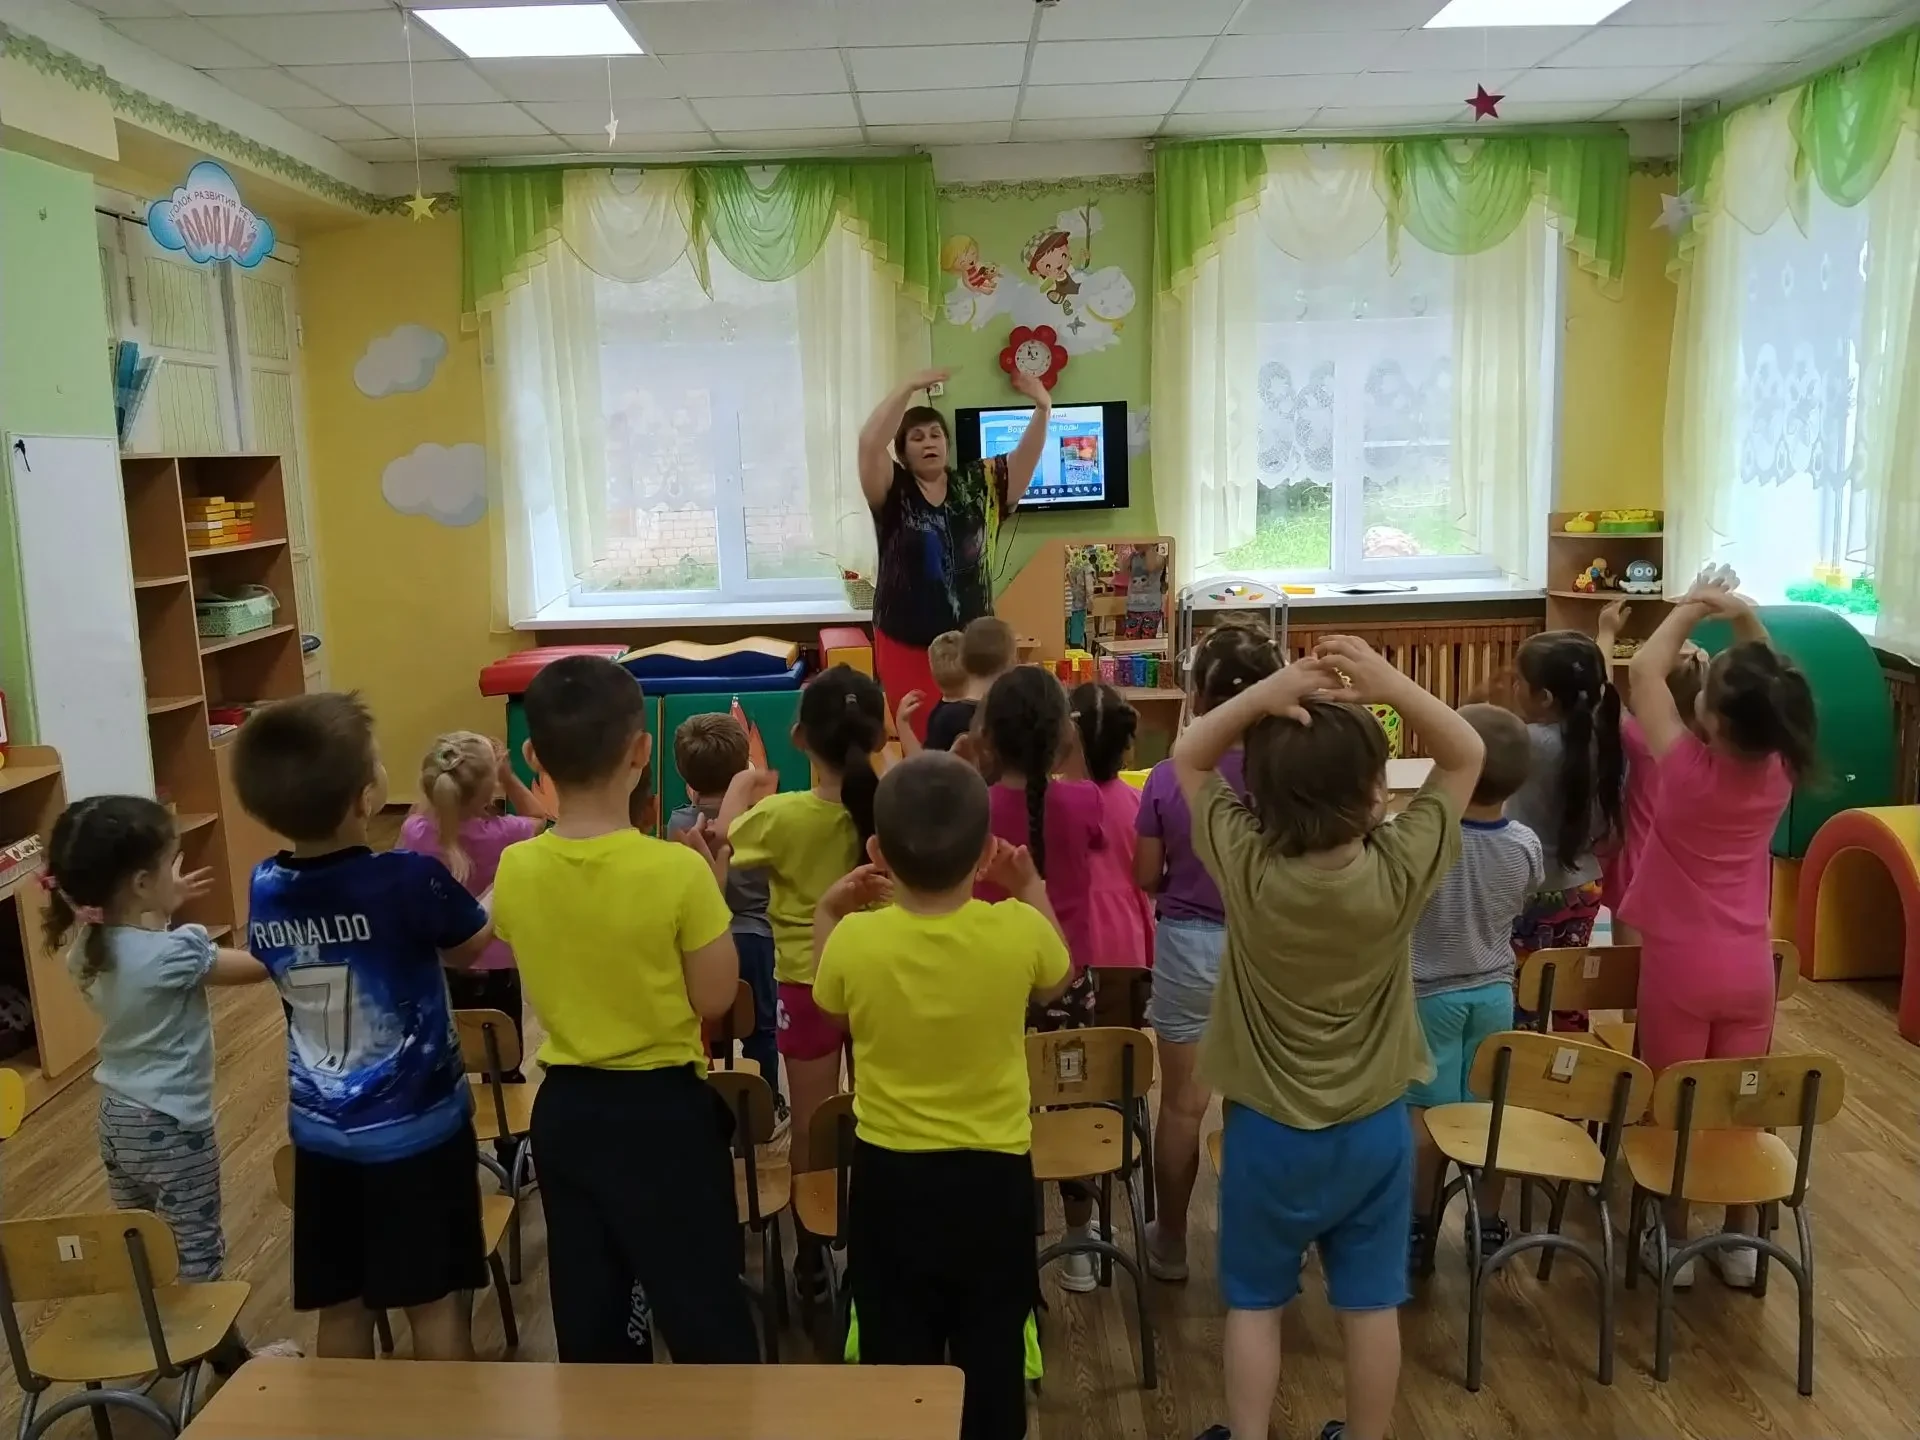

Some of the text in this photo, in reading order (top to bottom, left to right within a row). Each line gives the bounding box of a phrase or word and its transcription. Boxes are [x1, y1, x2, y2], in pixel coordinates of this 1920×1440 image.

[168, 190, 258, 232] УГОЛОК РАЗВИТИЯ РЕЧИ
[253, 914, 371, 949] RONALDO
[286, 962, 352, 1074] 7
[1746, 1073, 1756, 1086] 2
